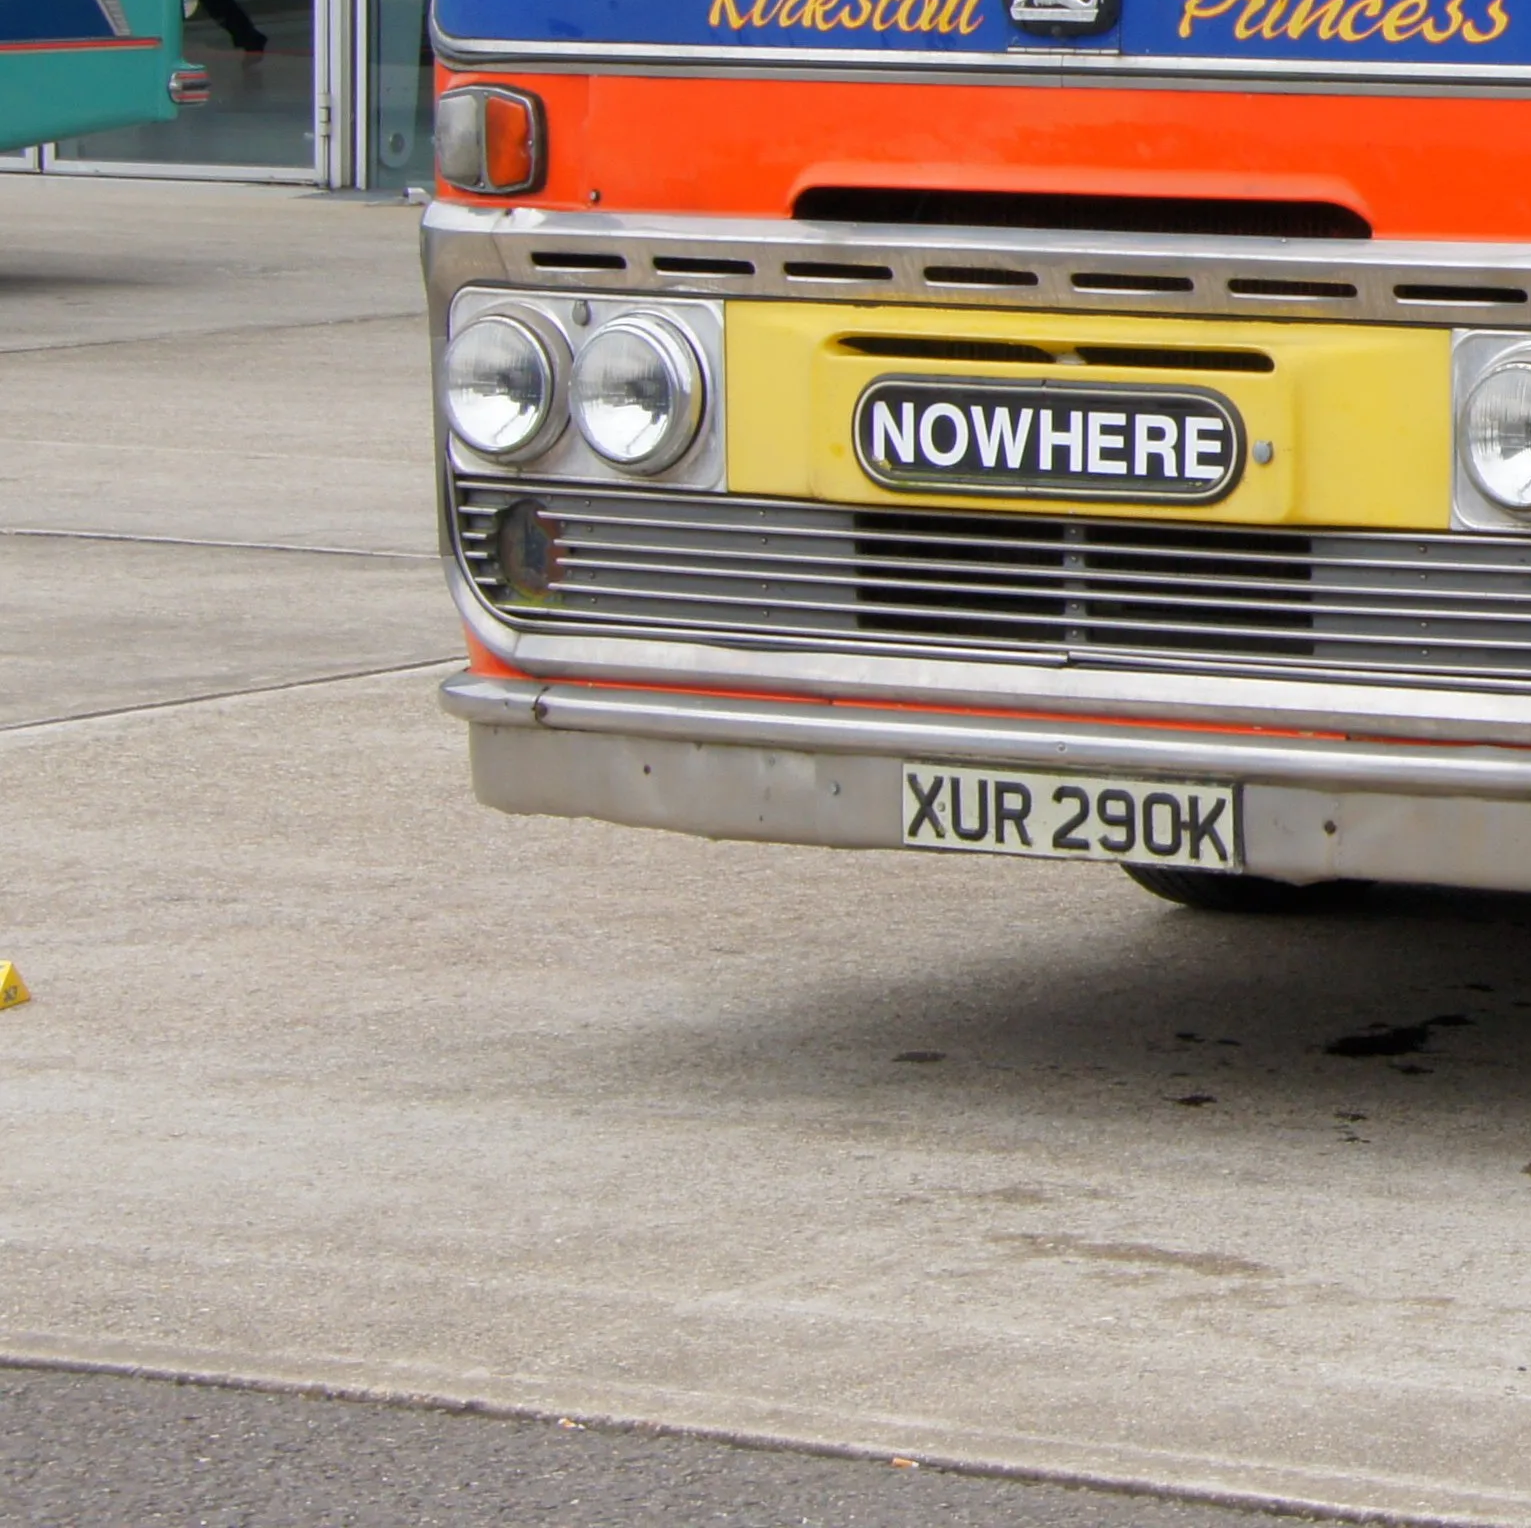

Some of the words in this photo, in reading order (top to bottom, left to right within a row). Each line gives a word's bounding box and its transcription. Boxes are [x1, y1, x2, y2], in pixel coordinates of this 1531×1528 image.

[872, 400, 1226, 480] NOWHERE
[907, 772, 1033, 847] XUR
[1051, 785, 1229, 862] 290K
